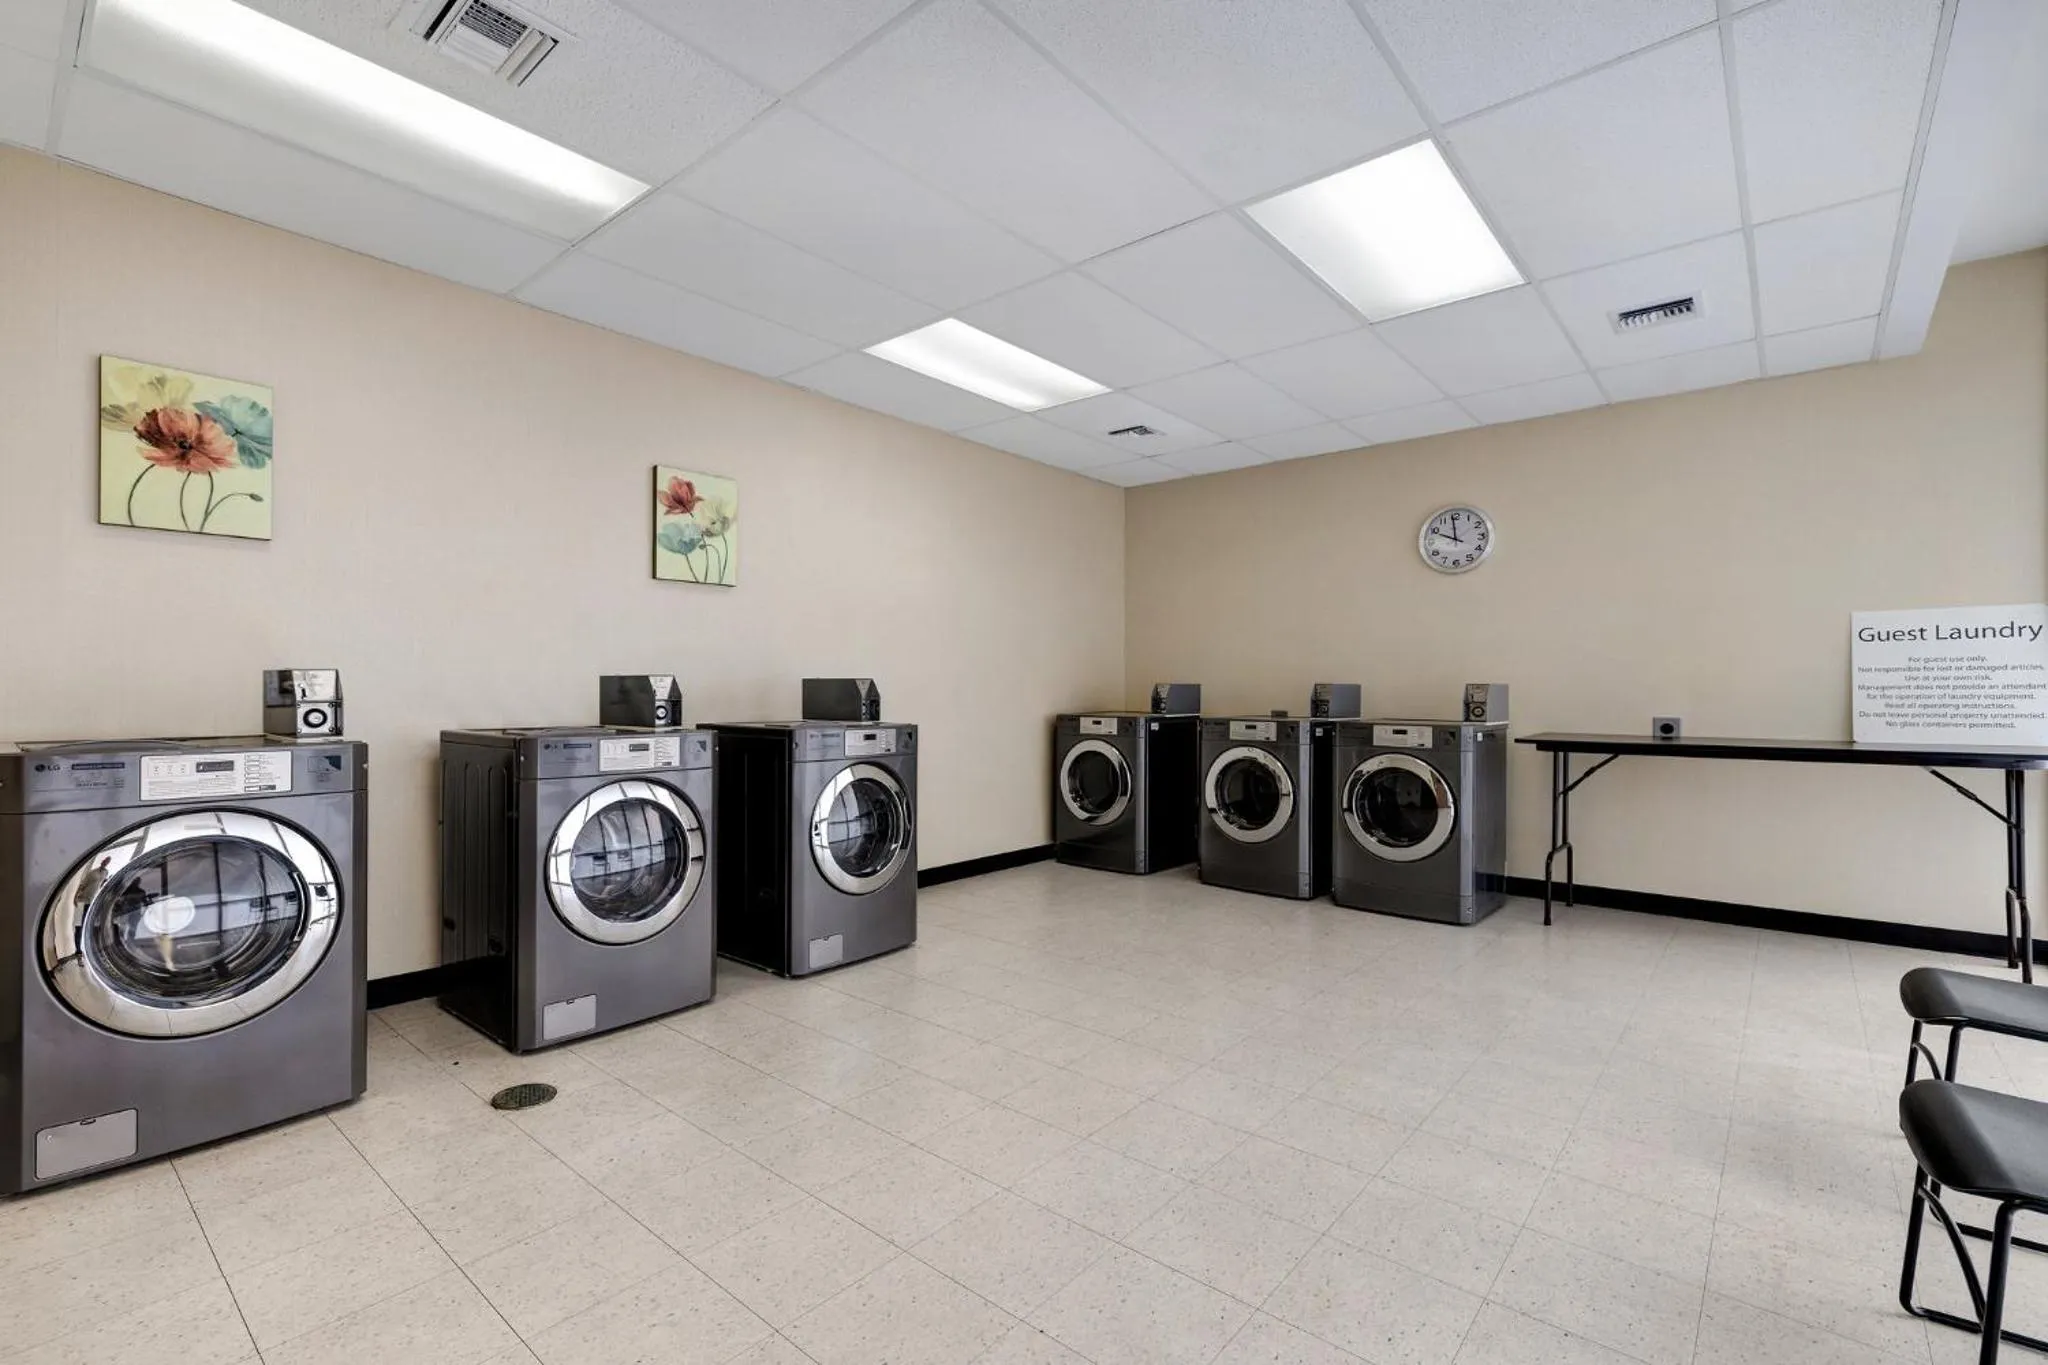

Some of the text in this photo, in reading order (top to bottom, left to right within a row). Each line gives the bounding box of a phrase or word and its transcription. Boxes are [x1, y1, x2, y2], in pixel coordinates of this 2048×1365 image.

[1474, 521, 1482, 529] 2
[1431, 527, 1440, 535] 10
[1477, 533, 1486, 541] 3
[1441, 556, 1448, 564] 7
[1466, 554, 1474, 562] 5
[1858, 620, 2043, 642] Guest Laundry
[1966, 655, 1988, 663] only.
[1874, 666, 1921, 674] responsible
[1966, 664, 2008, 673] damaged
[1858, 684, 1911, 692] Management
[1952, 683, 1985, 691] provide
[1948, 693, 1981, 701] laundry
[1983, 693, 2037, 701] equipment.
[1911, 711, 1947, 719] personal
[1968, 722, 2016, 730] permitted.
